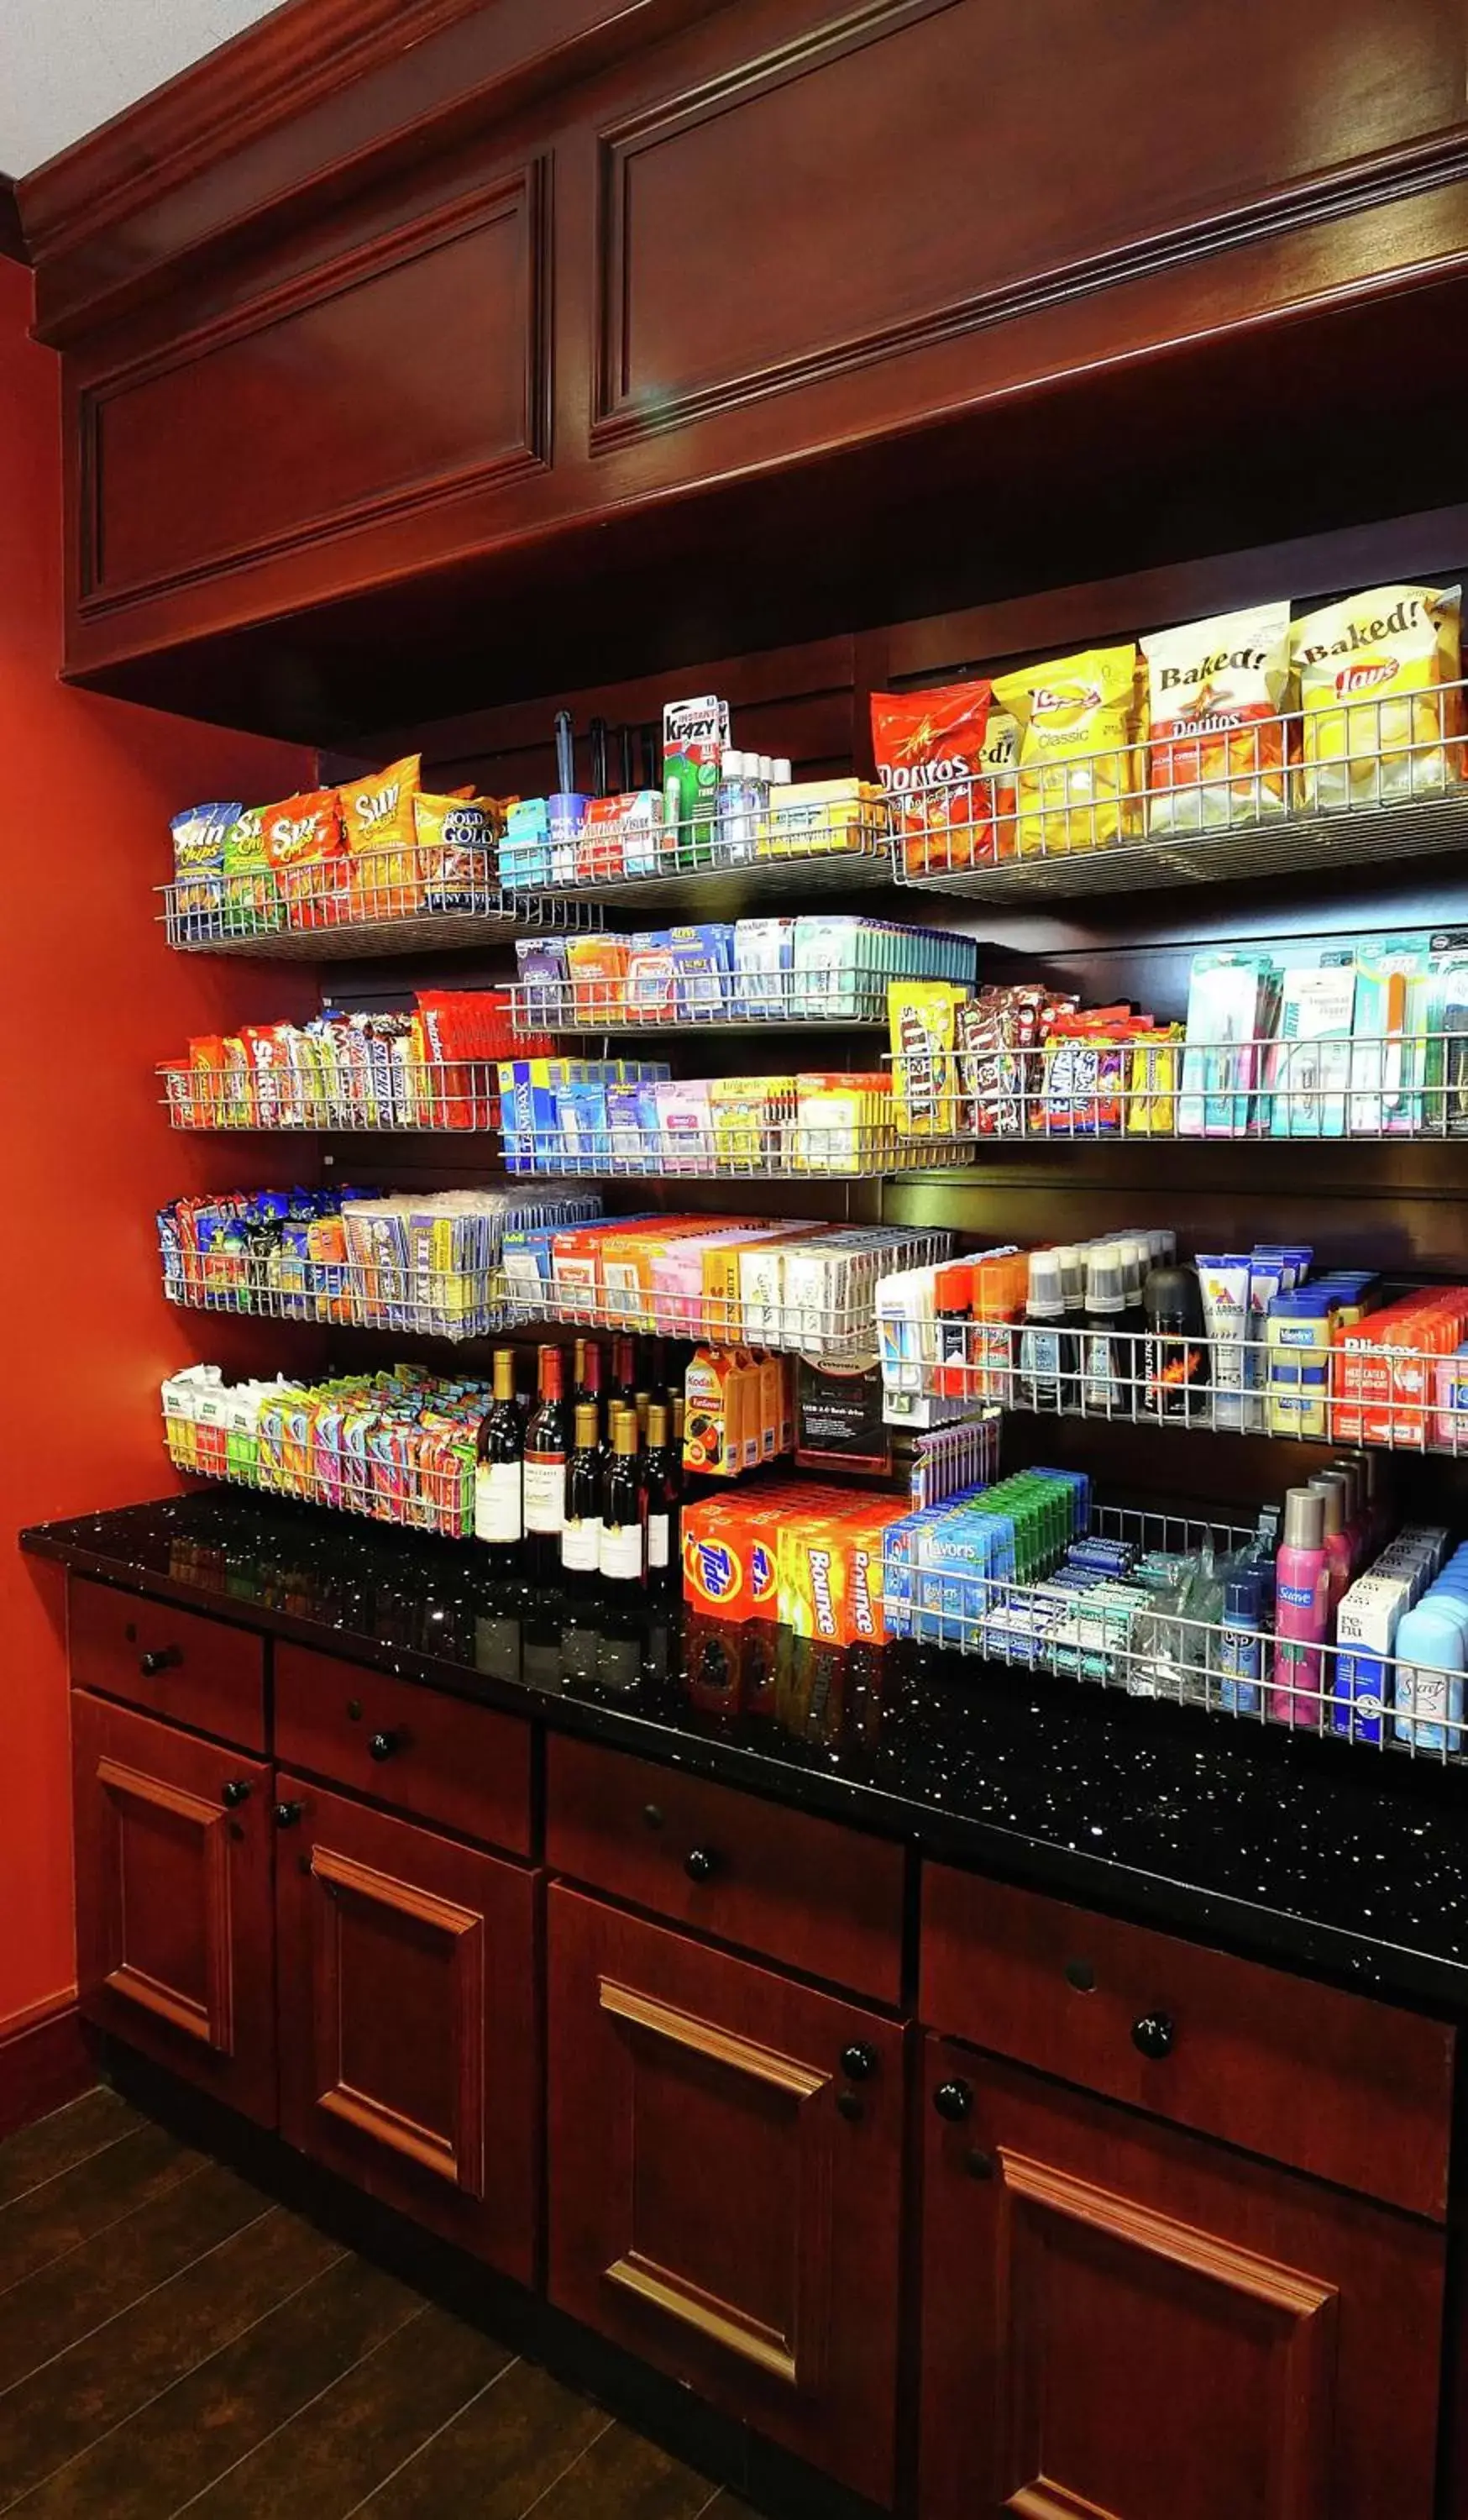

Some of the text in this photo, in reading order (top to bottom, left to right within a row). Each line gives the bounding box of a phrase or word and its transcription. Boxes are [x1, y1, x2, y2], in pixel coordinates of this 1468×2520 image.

[1303, 600, 1421, 665] Baked!
[1160, 648, 1266, 690] Baked!
[678, 710, 716, 723] INSTANT
[1172, 711, 1241, 738] Doritos
[978, 741, 1013, 764] ed!
[1039, 728, 1089, 748] Classic
[878, 754, 969, 792] Doritos
[355, 784, 400, 828] Sun
[444, 811, 484, 829] ROLD
[443, 825, 495, 846] GOLD
[1282, 1000, 1301, 1038] TRIM
[372, 1040, 391, 1121] SNICKERS
[392, 1052, 405, 1113] SNICKERS
[515, 1081, 532, 1152] TAMPAX
[1344, 1336, 1420, 1356] Blistex
[688, 1375, 714, 1389] Kodak
[802, 1404, 817, 1412] USB
[698, 1541, 731, 1596] Tide
[807, 1548, 836, 1637] Bounce
[853, 1549, 874, 1636] Bounce
[1278, 1586, 1312, 1604] Suave
[1340, 1624, 1362, 1638] nu
